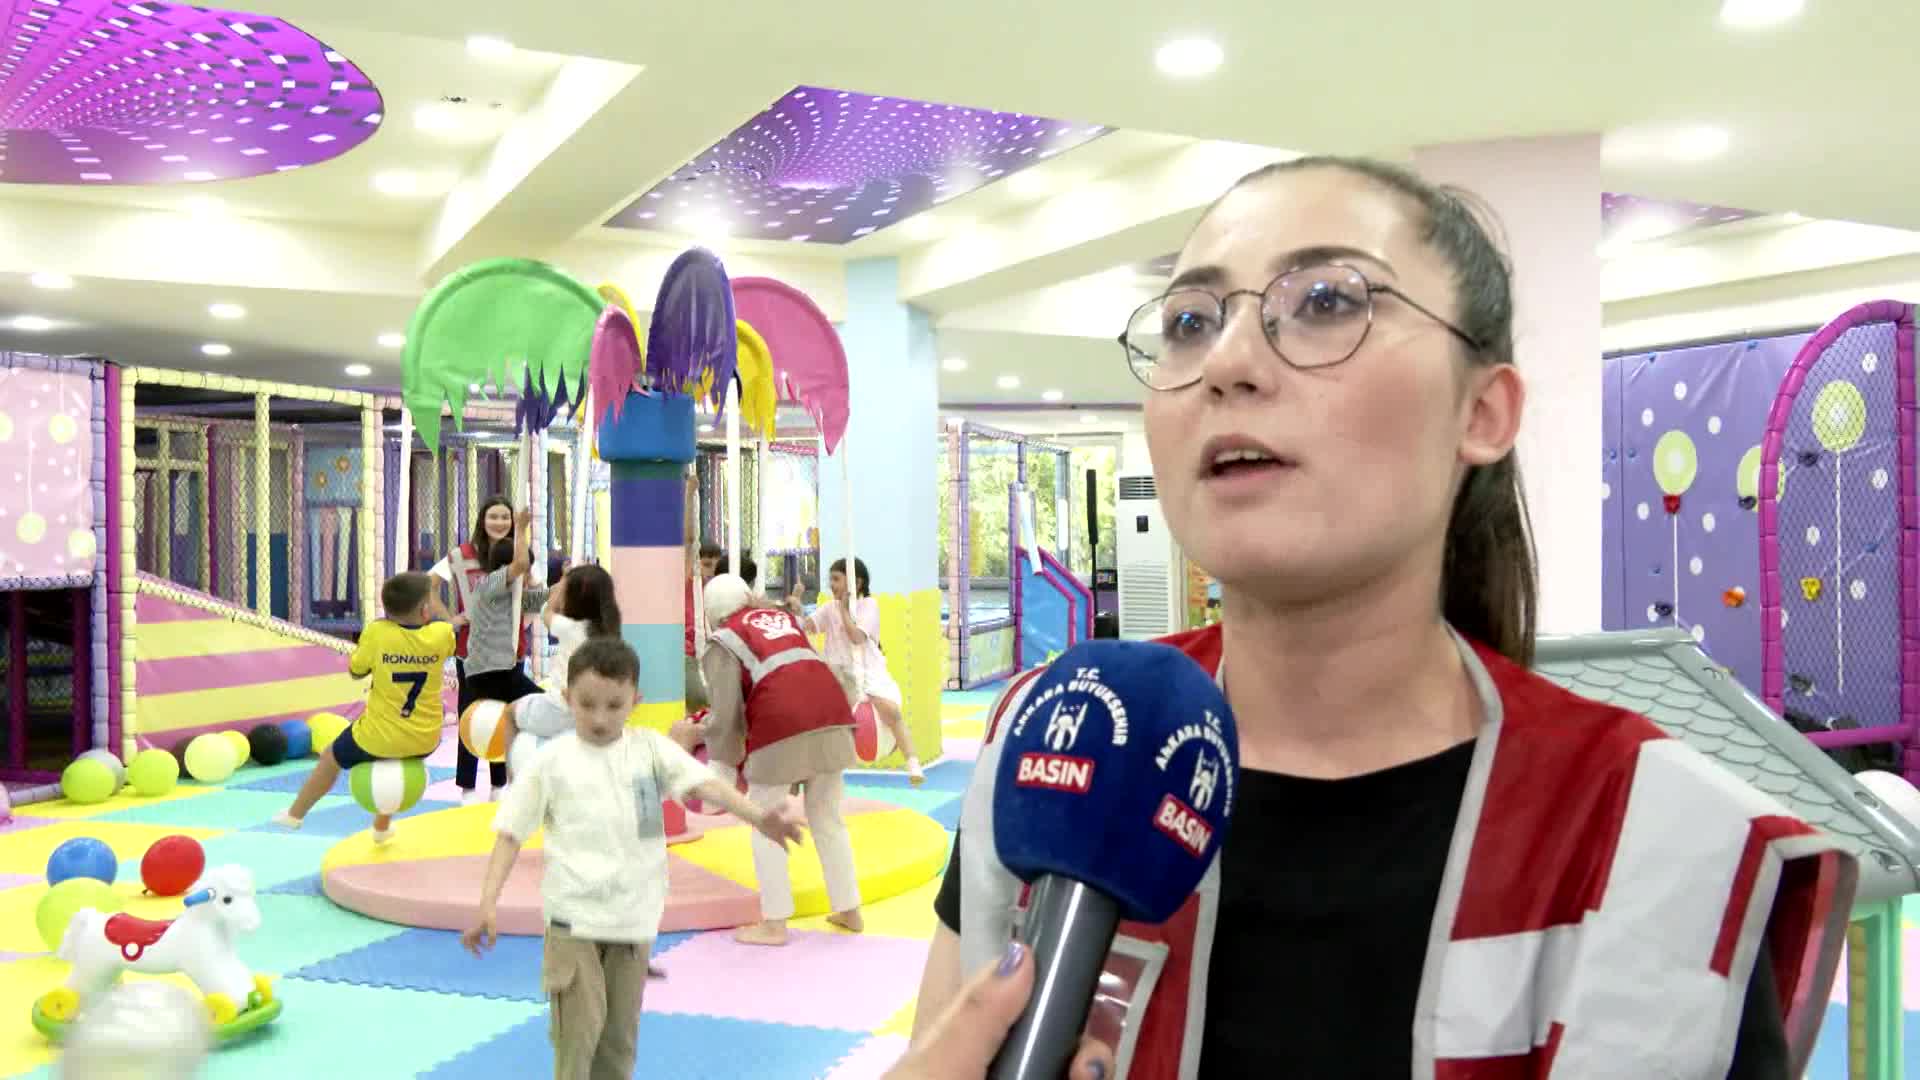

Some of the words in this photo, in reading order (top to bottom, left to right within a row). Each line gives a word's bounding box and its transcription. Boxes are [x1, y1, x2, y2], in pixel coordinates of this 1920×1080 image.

[382, 653, 439, 665] RONALDO
[392, 671, 428, 718] 7
[1017, 756, 1090, 789] BASIN
[1158, 801, 1213, 856] BASIN
